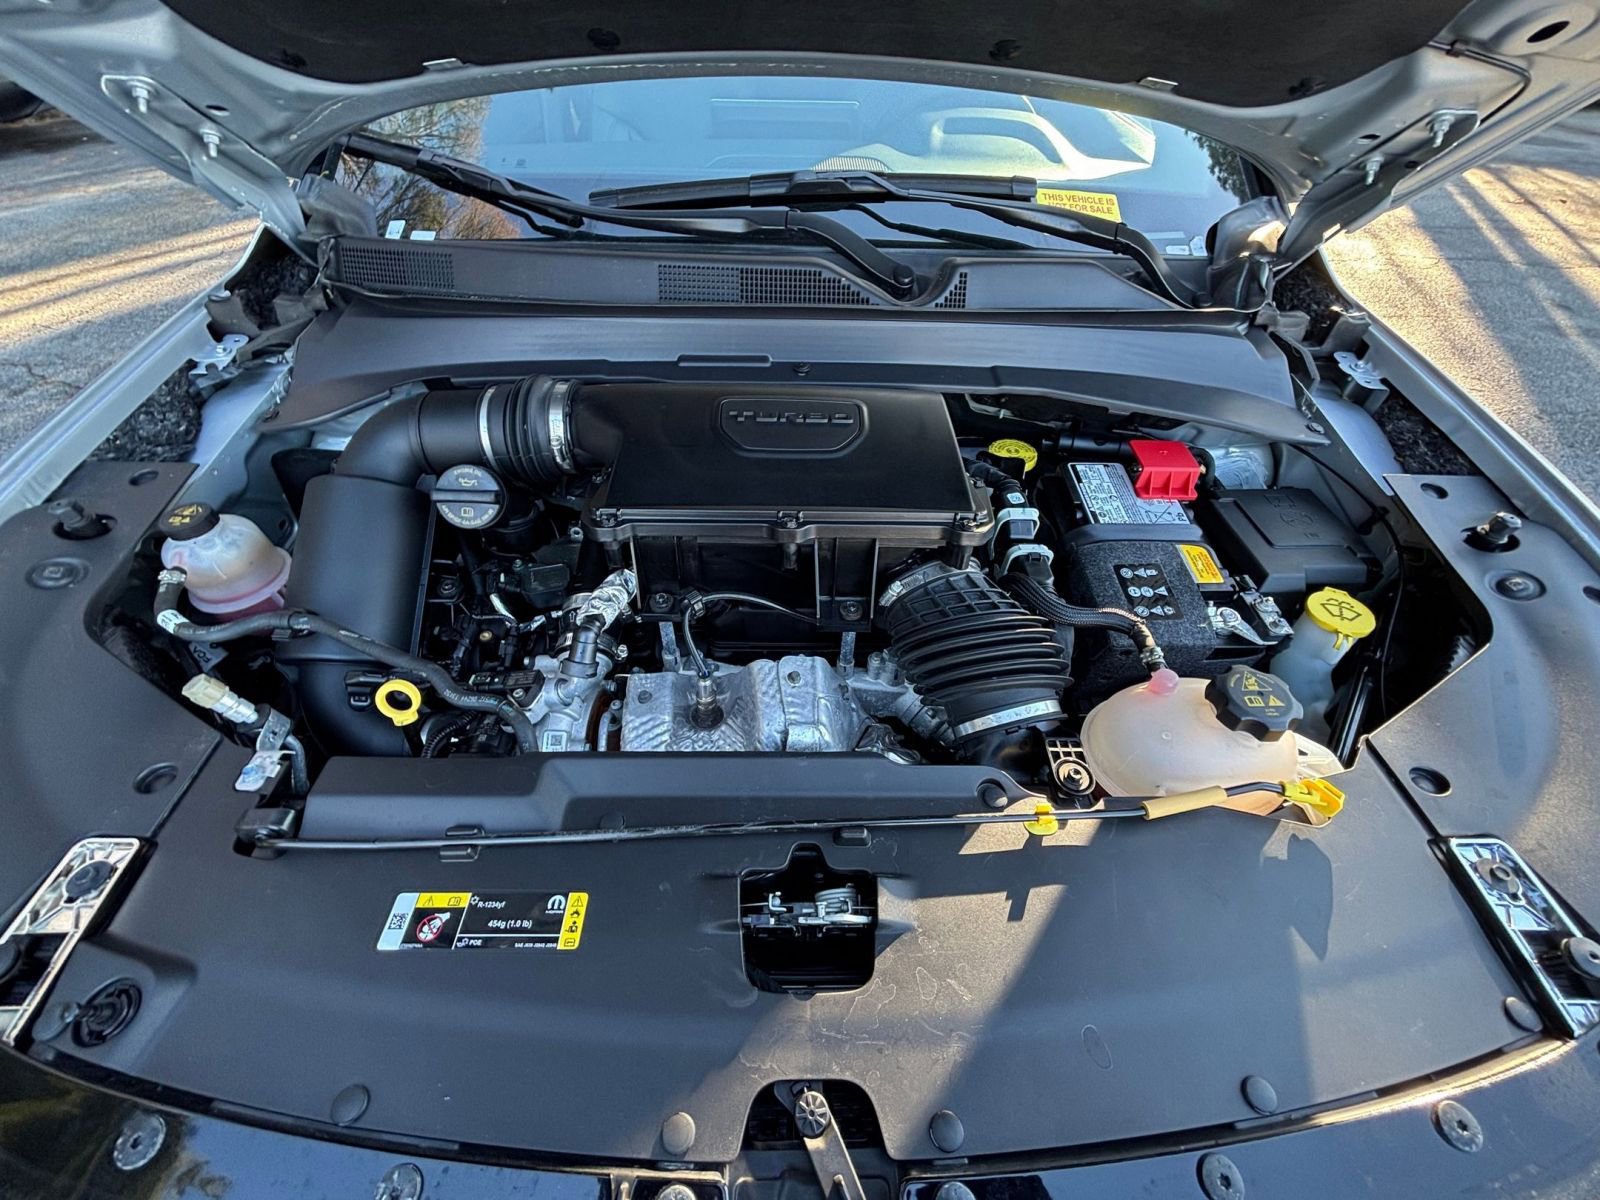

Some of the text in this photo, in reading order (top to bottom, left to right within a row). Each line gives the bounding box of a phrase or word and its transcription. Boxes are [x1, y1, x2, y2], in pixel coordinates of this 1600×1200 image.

[1042, 193, 1115, 206] THIS VEHICLE IS
[1069, 204, 1088, 212] FOR
[1089, 205, 1113, 215] SALE
[728, 410, 854, 424] TURBO
[477, 901, 506, 910] R-1234yf
[488, 920, 533, 929] 454g (1.0 lb)
